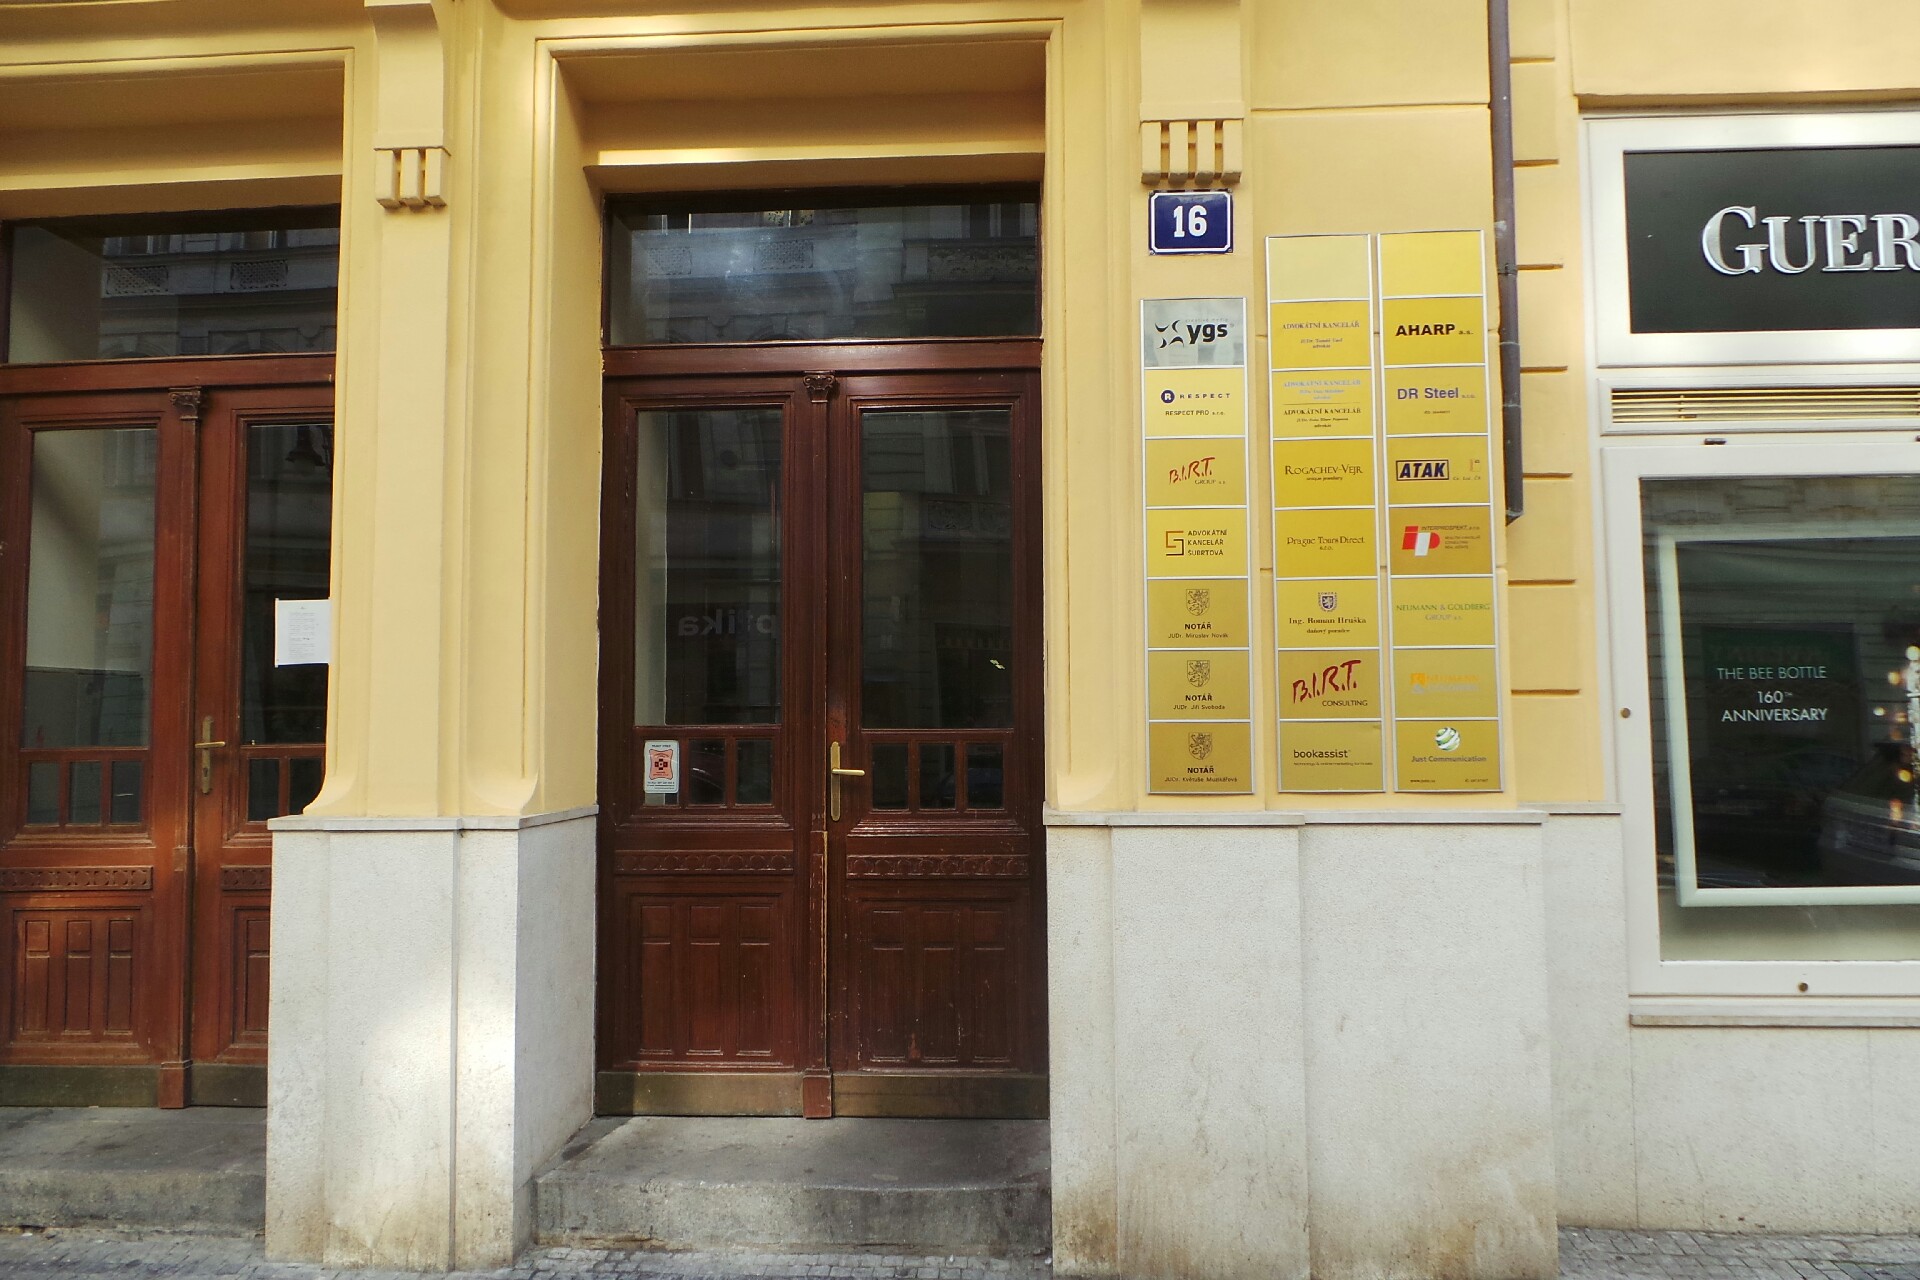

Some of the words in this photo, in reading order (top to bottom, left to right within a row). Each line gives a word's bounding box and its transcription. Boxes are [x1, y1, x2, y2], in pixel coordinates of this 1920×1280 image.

[1173, 204, 1208, 238] 16
[1701, 205, 1920, 276] GUER
[1186, 323, 1228, 345] ygs
[1395, 323, 1456, 337] AHARP
[1179, 392, 1231, 400] RESPECT
[1397, 387, 1419, 400] DR
[1424, 387, 1459, 399] Steel
[1165, 409, 1194, 417] RESPECT
[1399, 462, 1446, 479] ATAK
[1187, 528, 1227, 536] ADVOKÁTNÍ
[1187, 538, 1224, 546] KANCELÁŘ
[1287, 536, 1316, 548] Prague
[1318, 535, 1339, 545] Tours
[1339, 535, 1365, 545] Direct
[1289, 617, 1305, 625] Ing.
[1307, 616, 1335, 624] Roman
[1337, 615, 1367, 624] Hruška
[1184, 621, 1212, 630] NOTÁŘ
[1716, 667, 1745, 680] THE
[1748, 667, 1774, 680] BEE
[1778, 665, 1828, 679] BOTTLE
[1185, 692, 1213, 702] NOTÁŘ
[1321, 699, 1369, 707] CONSULTING
[1721, 707, 1828, 722] ANNIVERSARY
[1411, 755, 1427, 763] Just
[1187, 765, 1215, 774] NOTÁŘ
